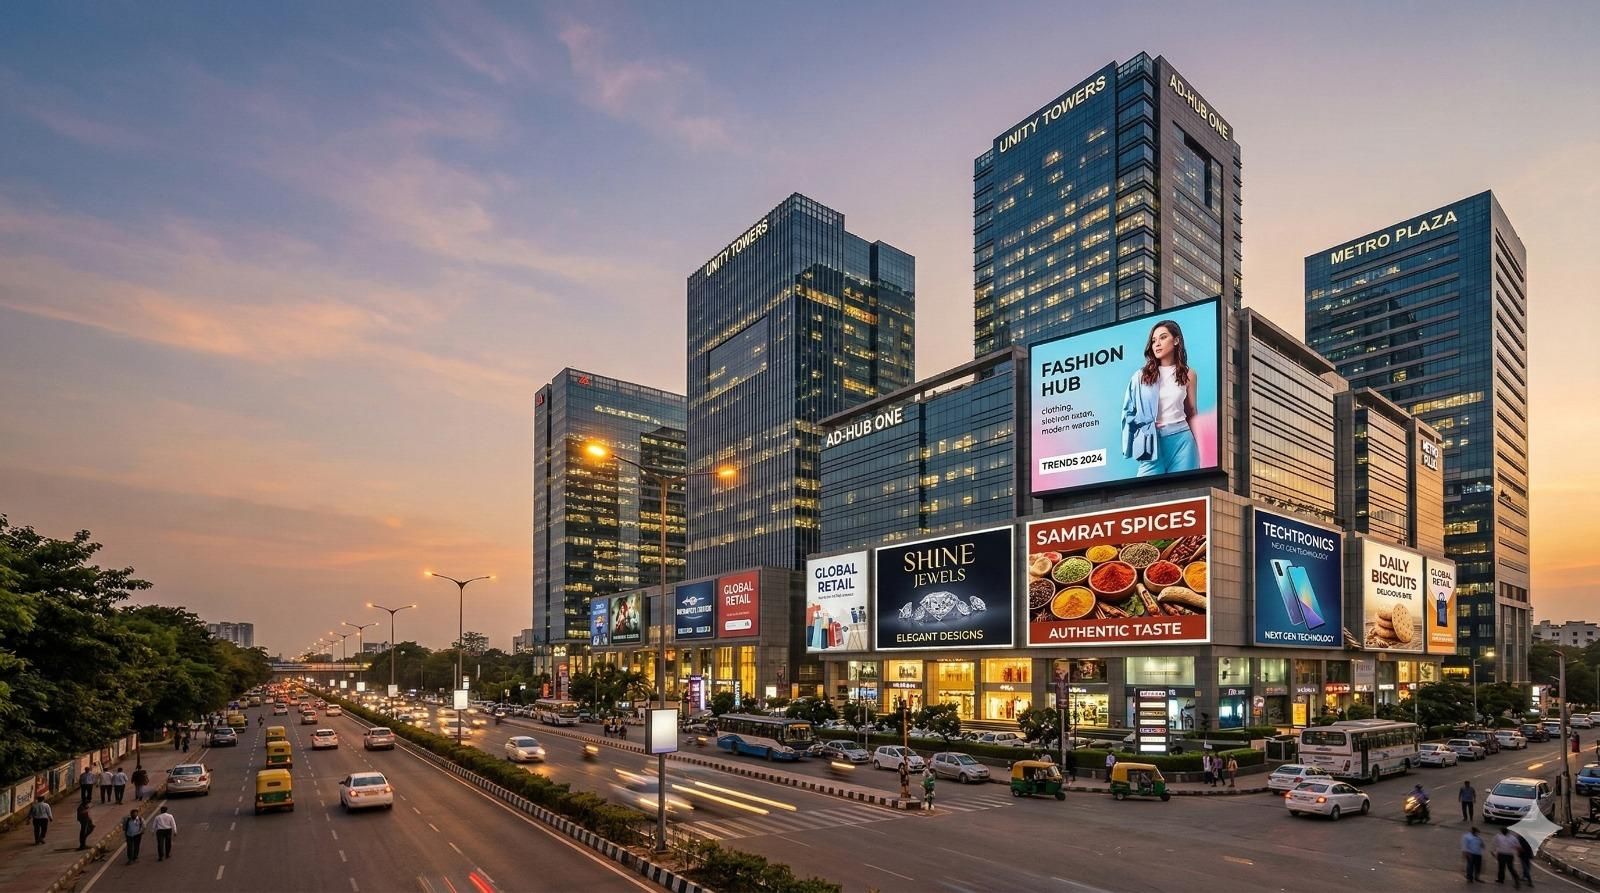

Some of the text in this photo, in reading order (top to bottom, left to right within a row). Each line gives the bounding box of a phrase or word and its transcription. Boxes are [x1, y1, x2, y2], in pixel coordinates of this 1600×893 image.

[1000, 75, 1106, 153] UNITY TOWERS
[1169, 73, 1228, 141] AD-HUB ONE
[1331, 210, 1458, 265] METRO PLAZA
[706, 219, 768, 277] UNITY TOWERS
[1042, 345, 1124, 377] FASHION
[1042, 376, 1081, 397] HUB
[826, 407, 903, 448] AD-HUB ONE
[1041, 425, 1070, 435] modern
[1042, 453, 1103, 470] TRENDS 2024
[1036, 509, 1196, 545] SAMRAT SPICES
[1262, 521, 1335, 552] TECHTRONICS
[904, 543, 976, 572] SHINE
[1379, 553, 1410, 573] DAILY
[815, 562, 858, 579] GLOBAL
[914, 568, 966, 588] JEWELS
[1371, 568, 1417, 590] BISCUITS
[1430, 568, 1453, 580] GLOBAL
[723, 581, 754, 595] GLOBAL
[818, 577, 855, 593] RETAIL
[1432, 577, 1451, 588] RETAIL
[725, 593, 752, 606] RETAIL
[896, 630, 984, 643] ELEGANT DESIGNS
[1049, 622, 1182, 639] AUTHENTIC TASTE
[1264, 631, 1282, 640] NEXT
[1283, 632, 1296, 640] GEN
